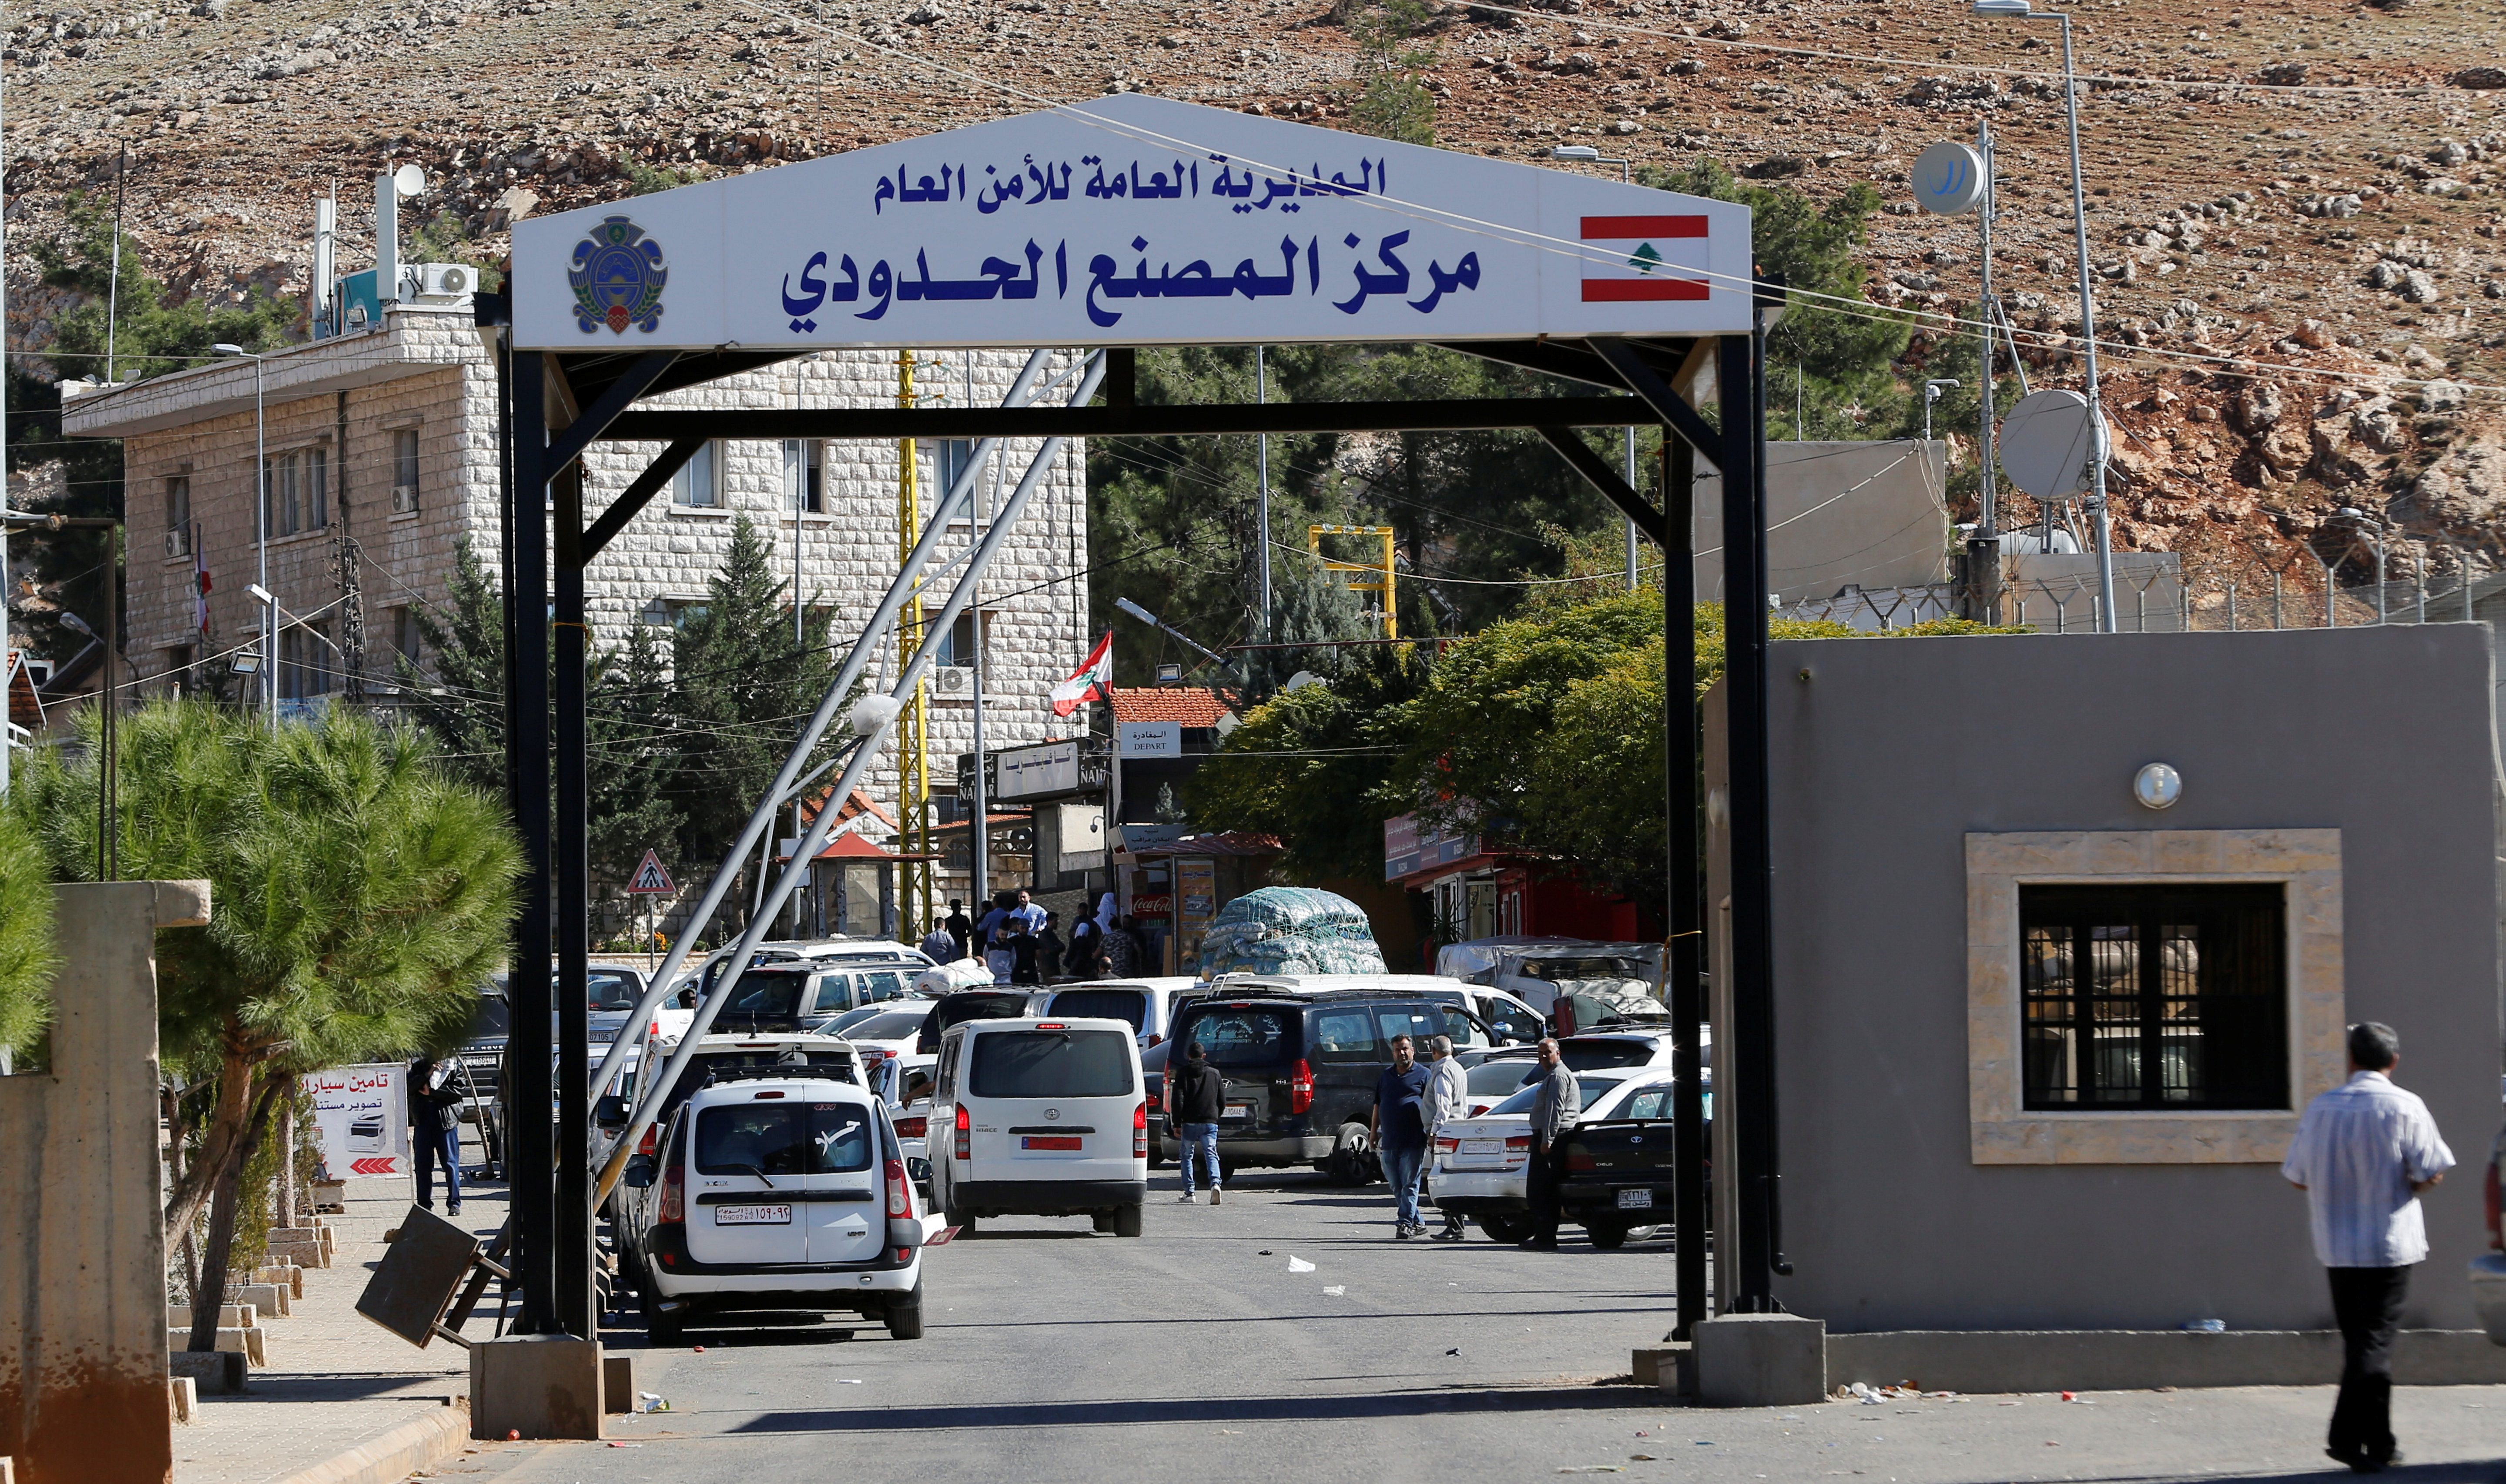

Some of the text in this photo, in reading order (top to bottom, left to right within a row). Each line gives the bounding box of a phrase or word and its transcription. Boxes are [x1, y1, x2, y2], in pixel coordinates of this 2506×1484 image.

[875, 155, 1385, 214] المديرية العامة للأمن العام
[783, 230, 1480, 332] مركز المصنع الحدودي
[1133, 730, 1166, 740] المغادرة
[959, 777, 995, 788] CAE
[349, 1070, 388, 1093] تأمين
[315, 1098, 382, 1111] تصوير مستند
[756, 1207, 788, 1220] ١٥٩٠٩٢
